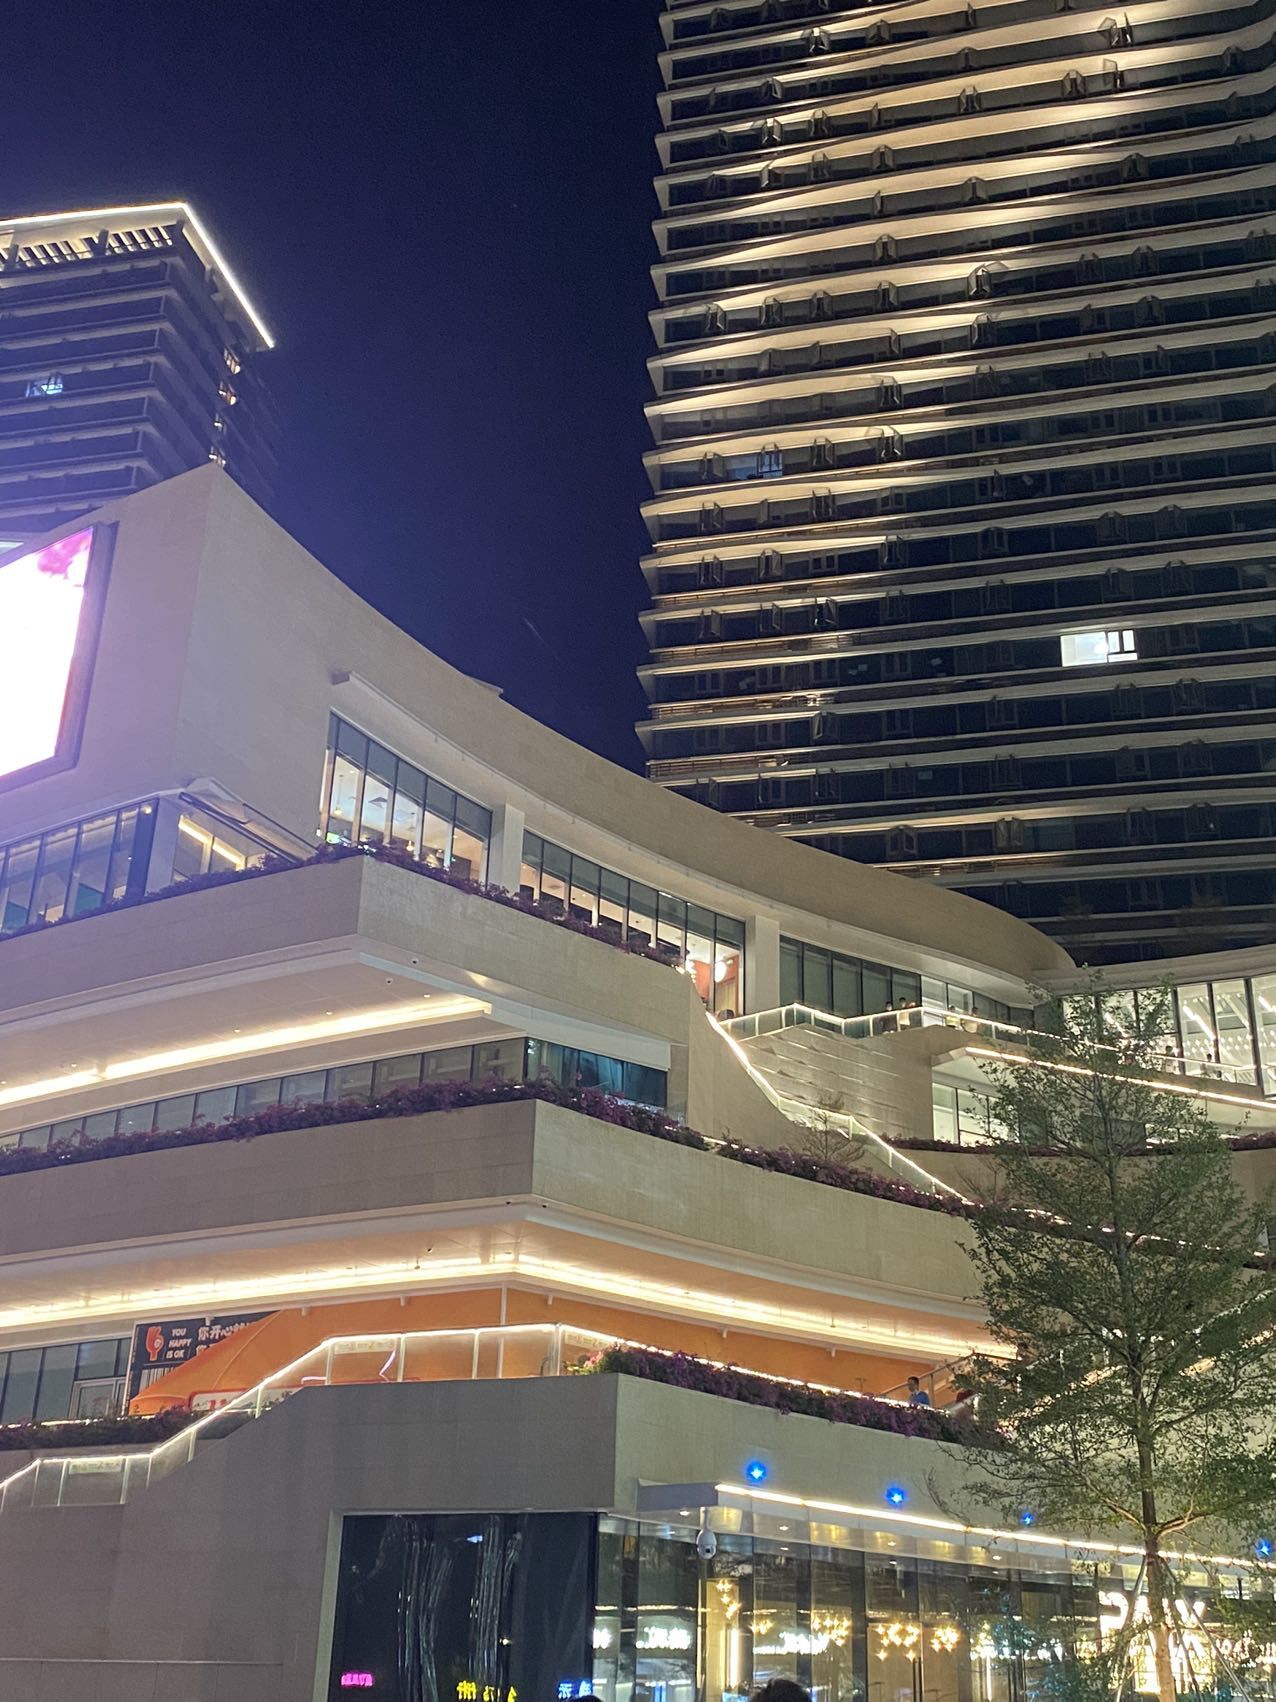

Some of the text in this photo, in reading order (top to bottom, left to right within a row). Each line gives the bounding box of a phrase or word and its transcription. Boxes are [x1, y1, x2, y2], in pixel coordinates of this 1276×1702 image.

[172, 1327, 187, 1337] YOU
[168, 1338, 193, 1348] HAPPY
[166, 1350, 174, 1359] IS
[174, 1349, 185, 1359] OK
